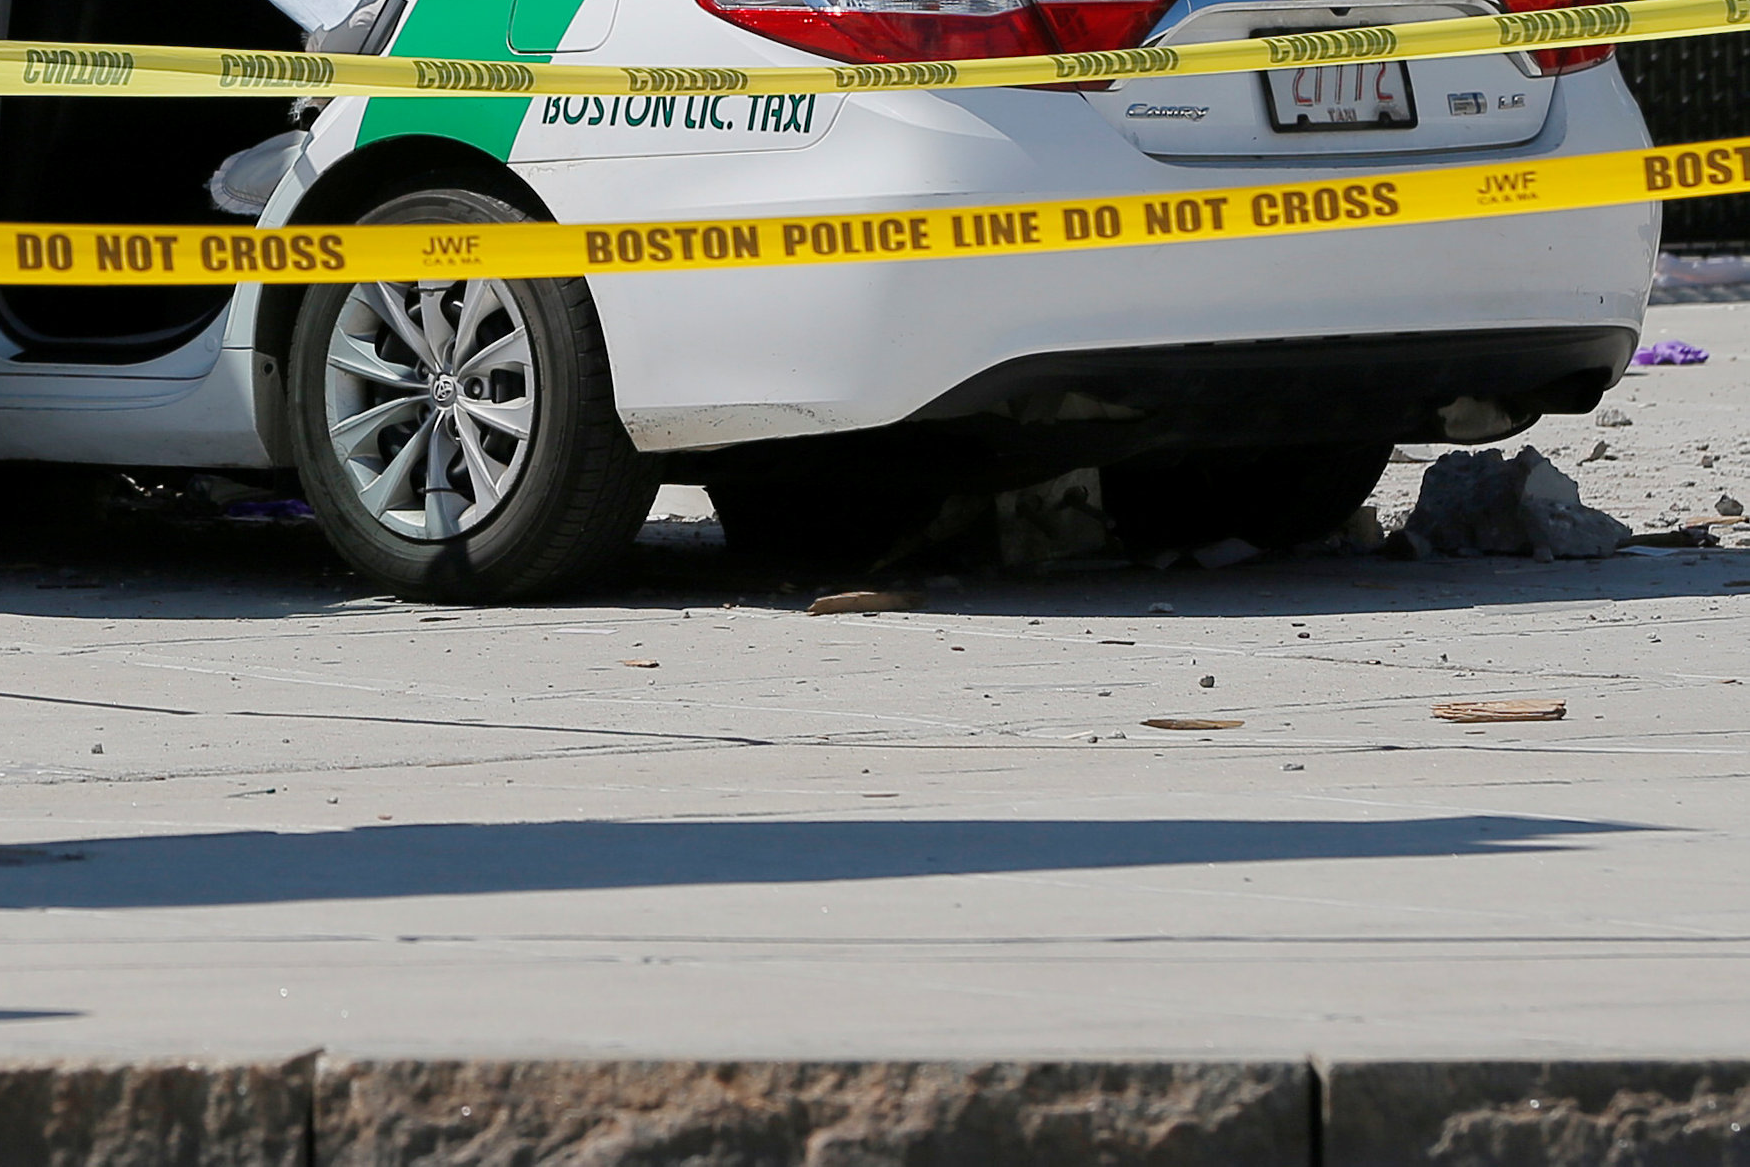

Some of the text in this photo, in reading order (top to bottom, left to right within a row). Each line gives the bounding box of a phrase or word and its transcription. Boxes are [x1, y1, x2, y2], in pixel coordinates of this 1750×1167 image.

[747, 94, 817, 133] TAXI
[1478, 170, 1538, 194] JWF
[586, 181, 1400, 265] BOSTON POLICE LINE DO NOT CROSS
[16, 233, 74, 272] DO
[96, 234, 178, 273] NOT
[200, 233, 347, 272] CROSS
[422, 235, 480, 256] JWF
